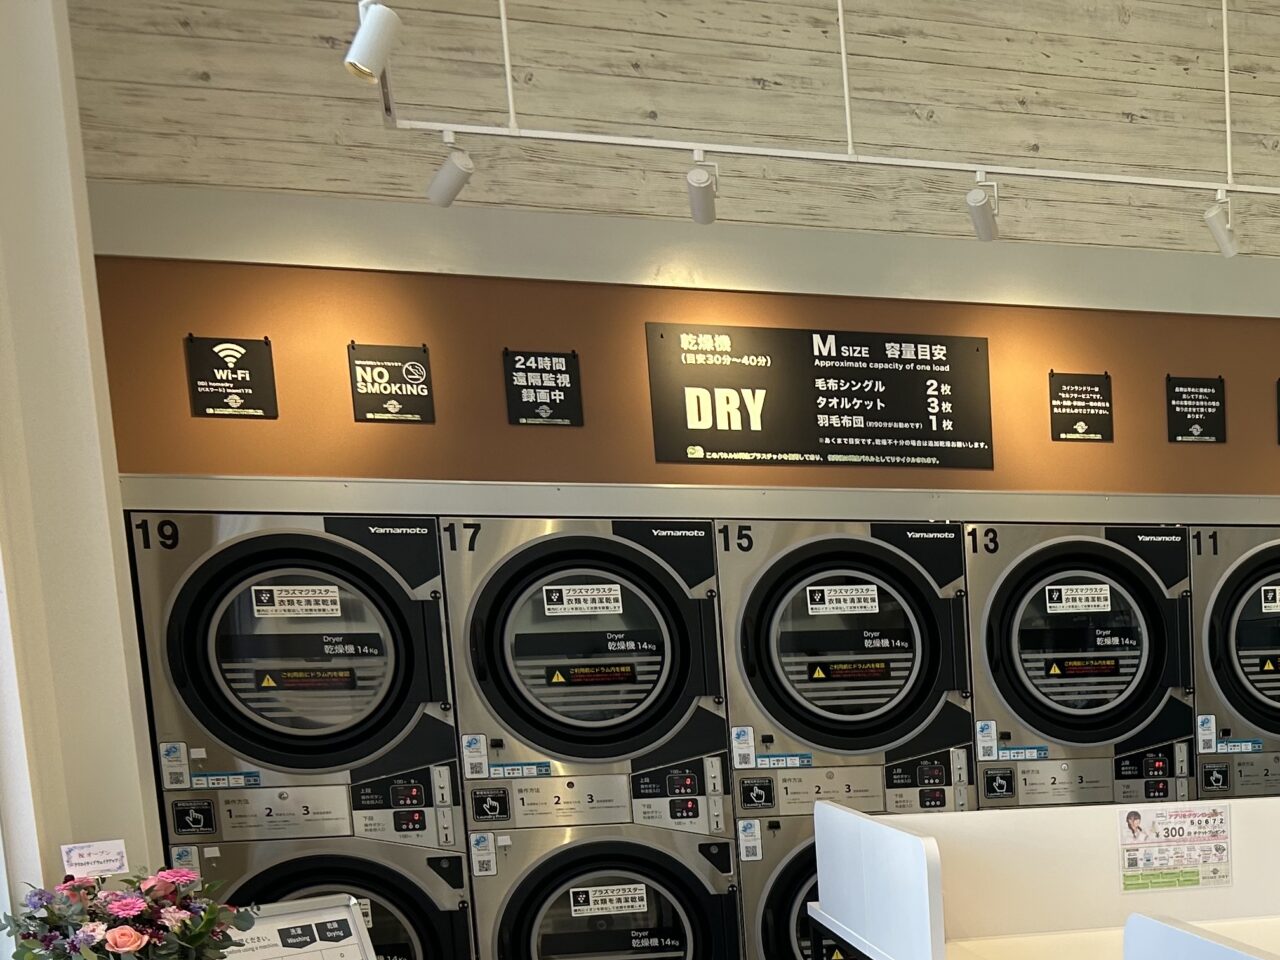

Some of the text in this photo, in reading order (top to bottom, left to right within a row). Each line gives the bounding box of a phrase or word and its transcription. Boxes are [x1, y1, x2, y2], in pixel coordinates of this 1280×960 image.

[680, 333, 731, 351] 乾燥機
[812, 334, 947, 361] M SIZE 容量目安
[515, 356, 566, 370] 24時間
[814, 359, 867, 369] Approximate
[869, 361, 903, 371] capacity
[905, 362, 913, 370] of
[933, 363, 949, 371] load
[214, 369, 250, 380] Wi-Fi
[356, 366, 389, 383] NO
[513, 372, 571, 387] 遠隔監視
[357, 382, 428, 396] SMOKING
[815, 378, 885, 392] 毛布シングル
[522, 389, 564, 403] 録画中
[685, 387, 766, 431] DRY
[817, 397, 885, 410] タオルケット
[817, 415, 864, 428] 羽毛布団
[135, 520, 178, 550] 19
[368, 526, 427, 534] Yamamoto
[443, 522, 482, 551] 17
[718, 525, 753, 552] 15
[967, 528, 999, 553] 13
[1192, 531, 1218, 555] 11
[323, 635, 342, 643] Dryer
[1238, 770, 1243, 778] 1
[1023, 776, 1084, 786] 1 2 3
[784, 784, 851, 795] 1 2 3
[520, 794, 594, 806] 1 2 3
[227, 806, 310, 818] 1 2 3
[1163, 827, 1184, 838] 300
[286, 935, 310, 943] Washing
[327, 930, 344, 938] Drying
